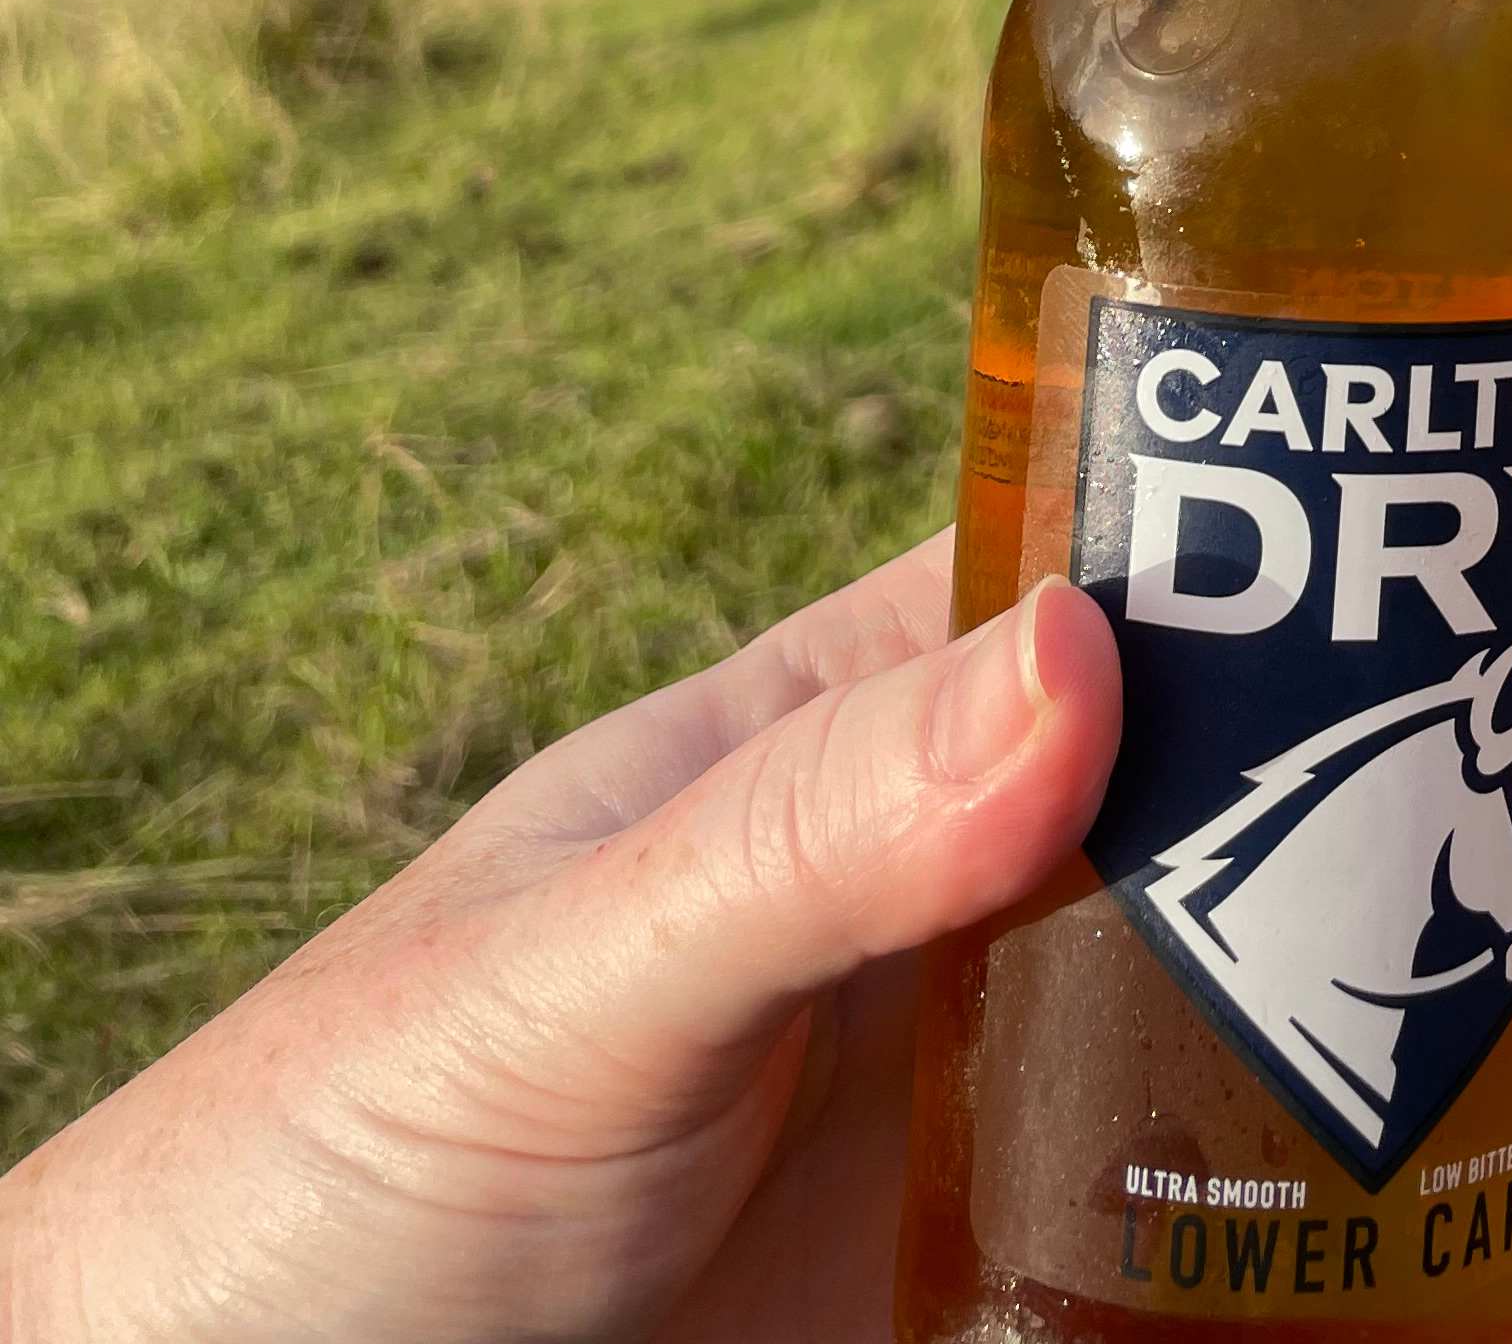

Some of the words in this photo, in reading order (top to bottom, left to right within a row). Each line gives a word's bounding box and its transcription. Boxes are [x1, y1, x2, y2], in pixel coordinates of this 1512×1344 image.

[1126, 1164, 1198, 1204] ULTRA
[1206, 1178, 1306, 1209] SMOOTH
[1420, 1161, 1462, 1196] LOW
[1121, 1201, 1379, 1294] LOWER
